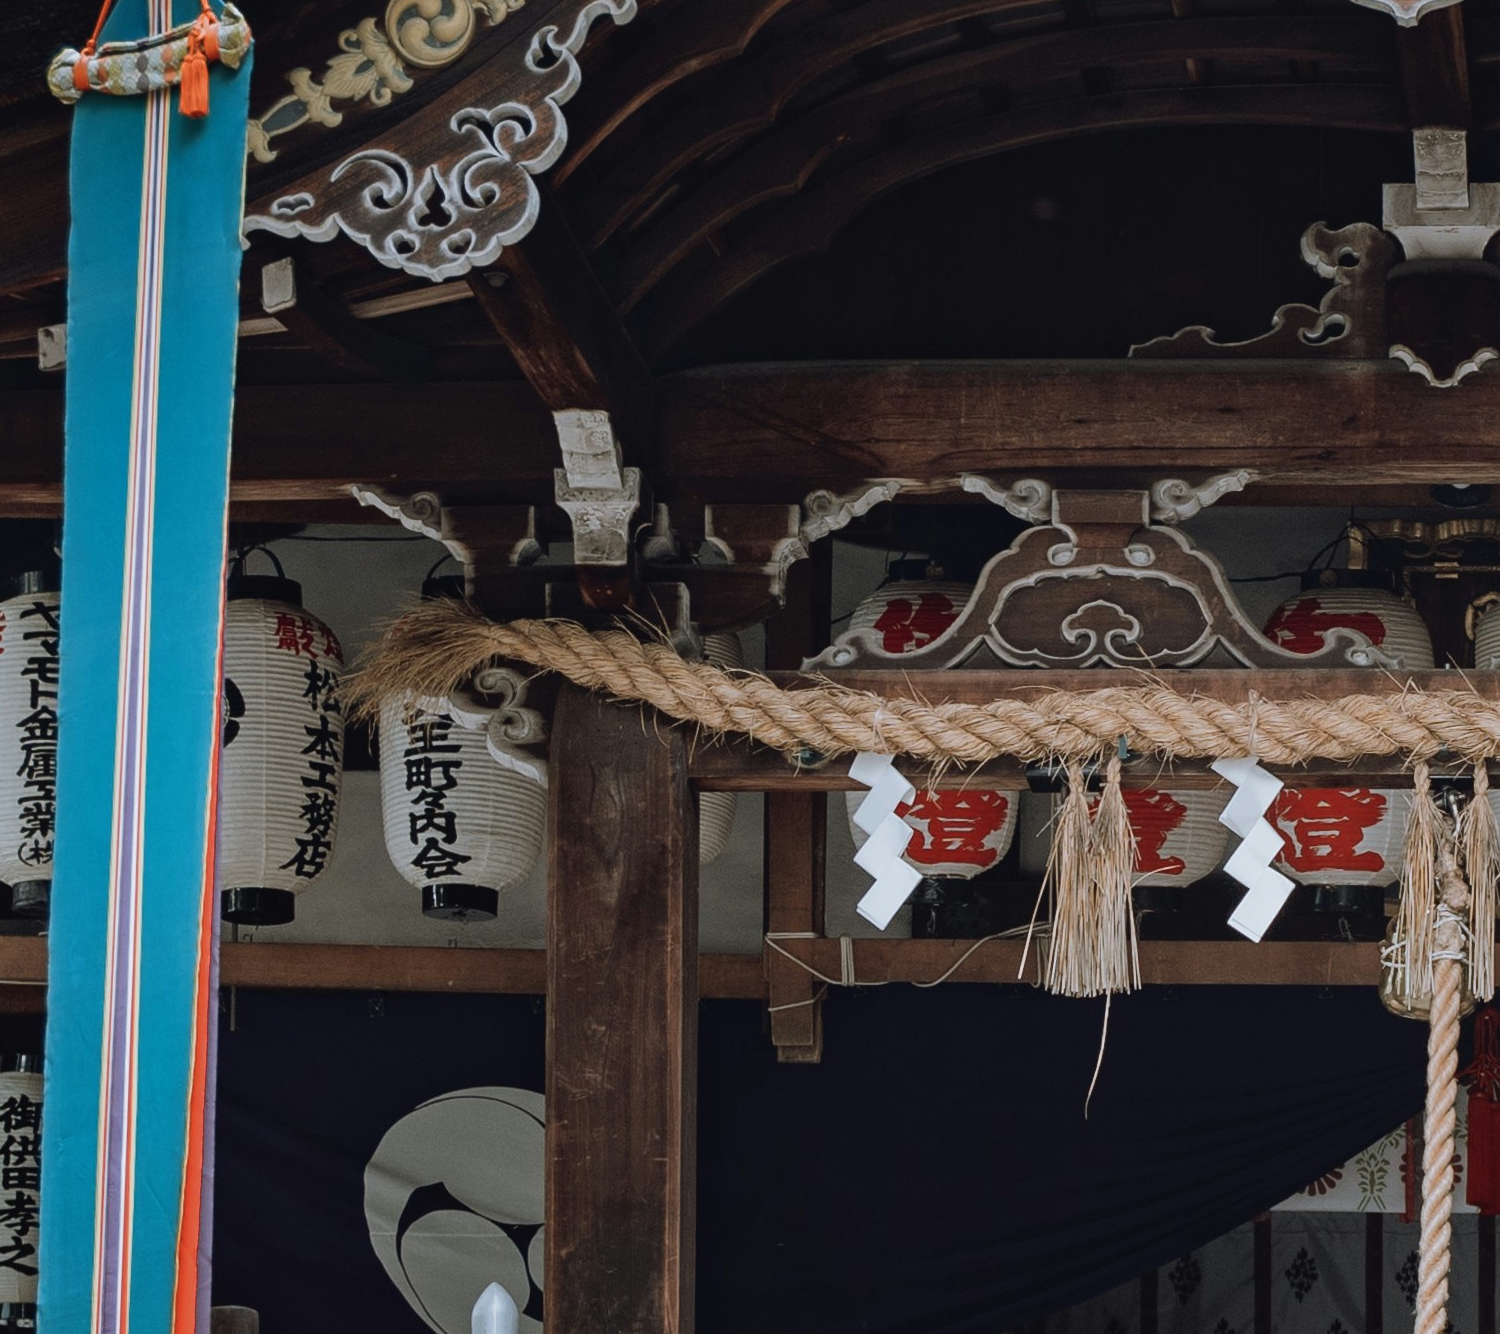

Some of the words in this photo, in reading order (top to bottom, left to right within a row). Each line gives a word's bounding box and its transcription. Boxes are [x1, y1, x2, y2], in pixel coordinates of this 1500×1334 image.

[279, 659, 341, 879] 松本工務店
